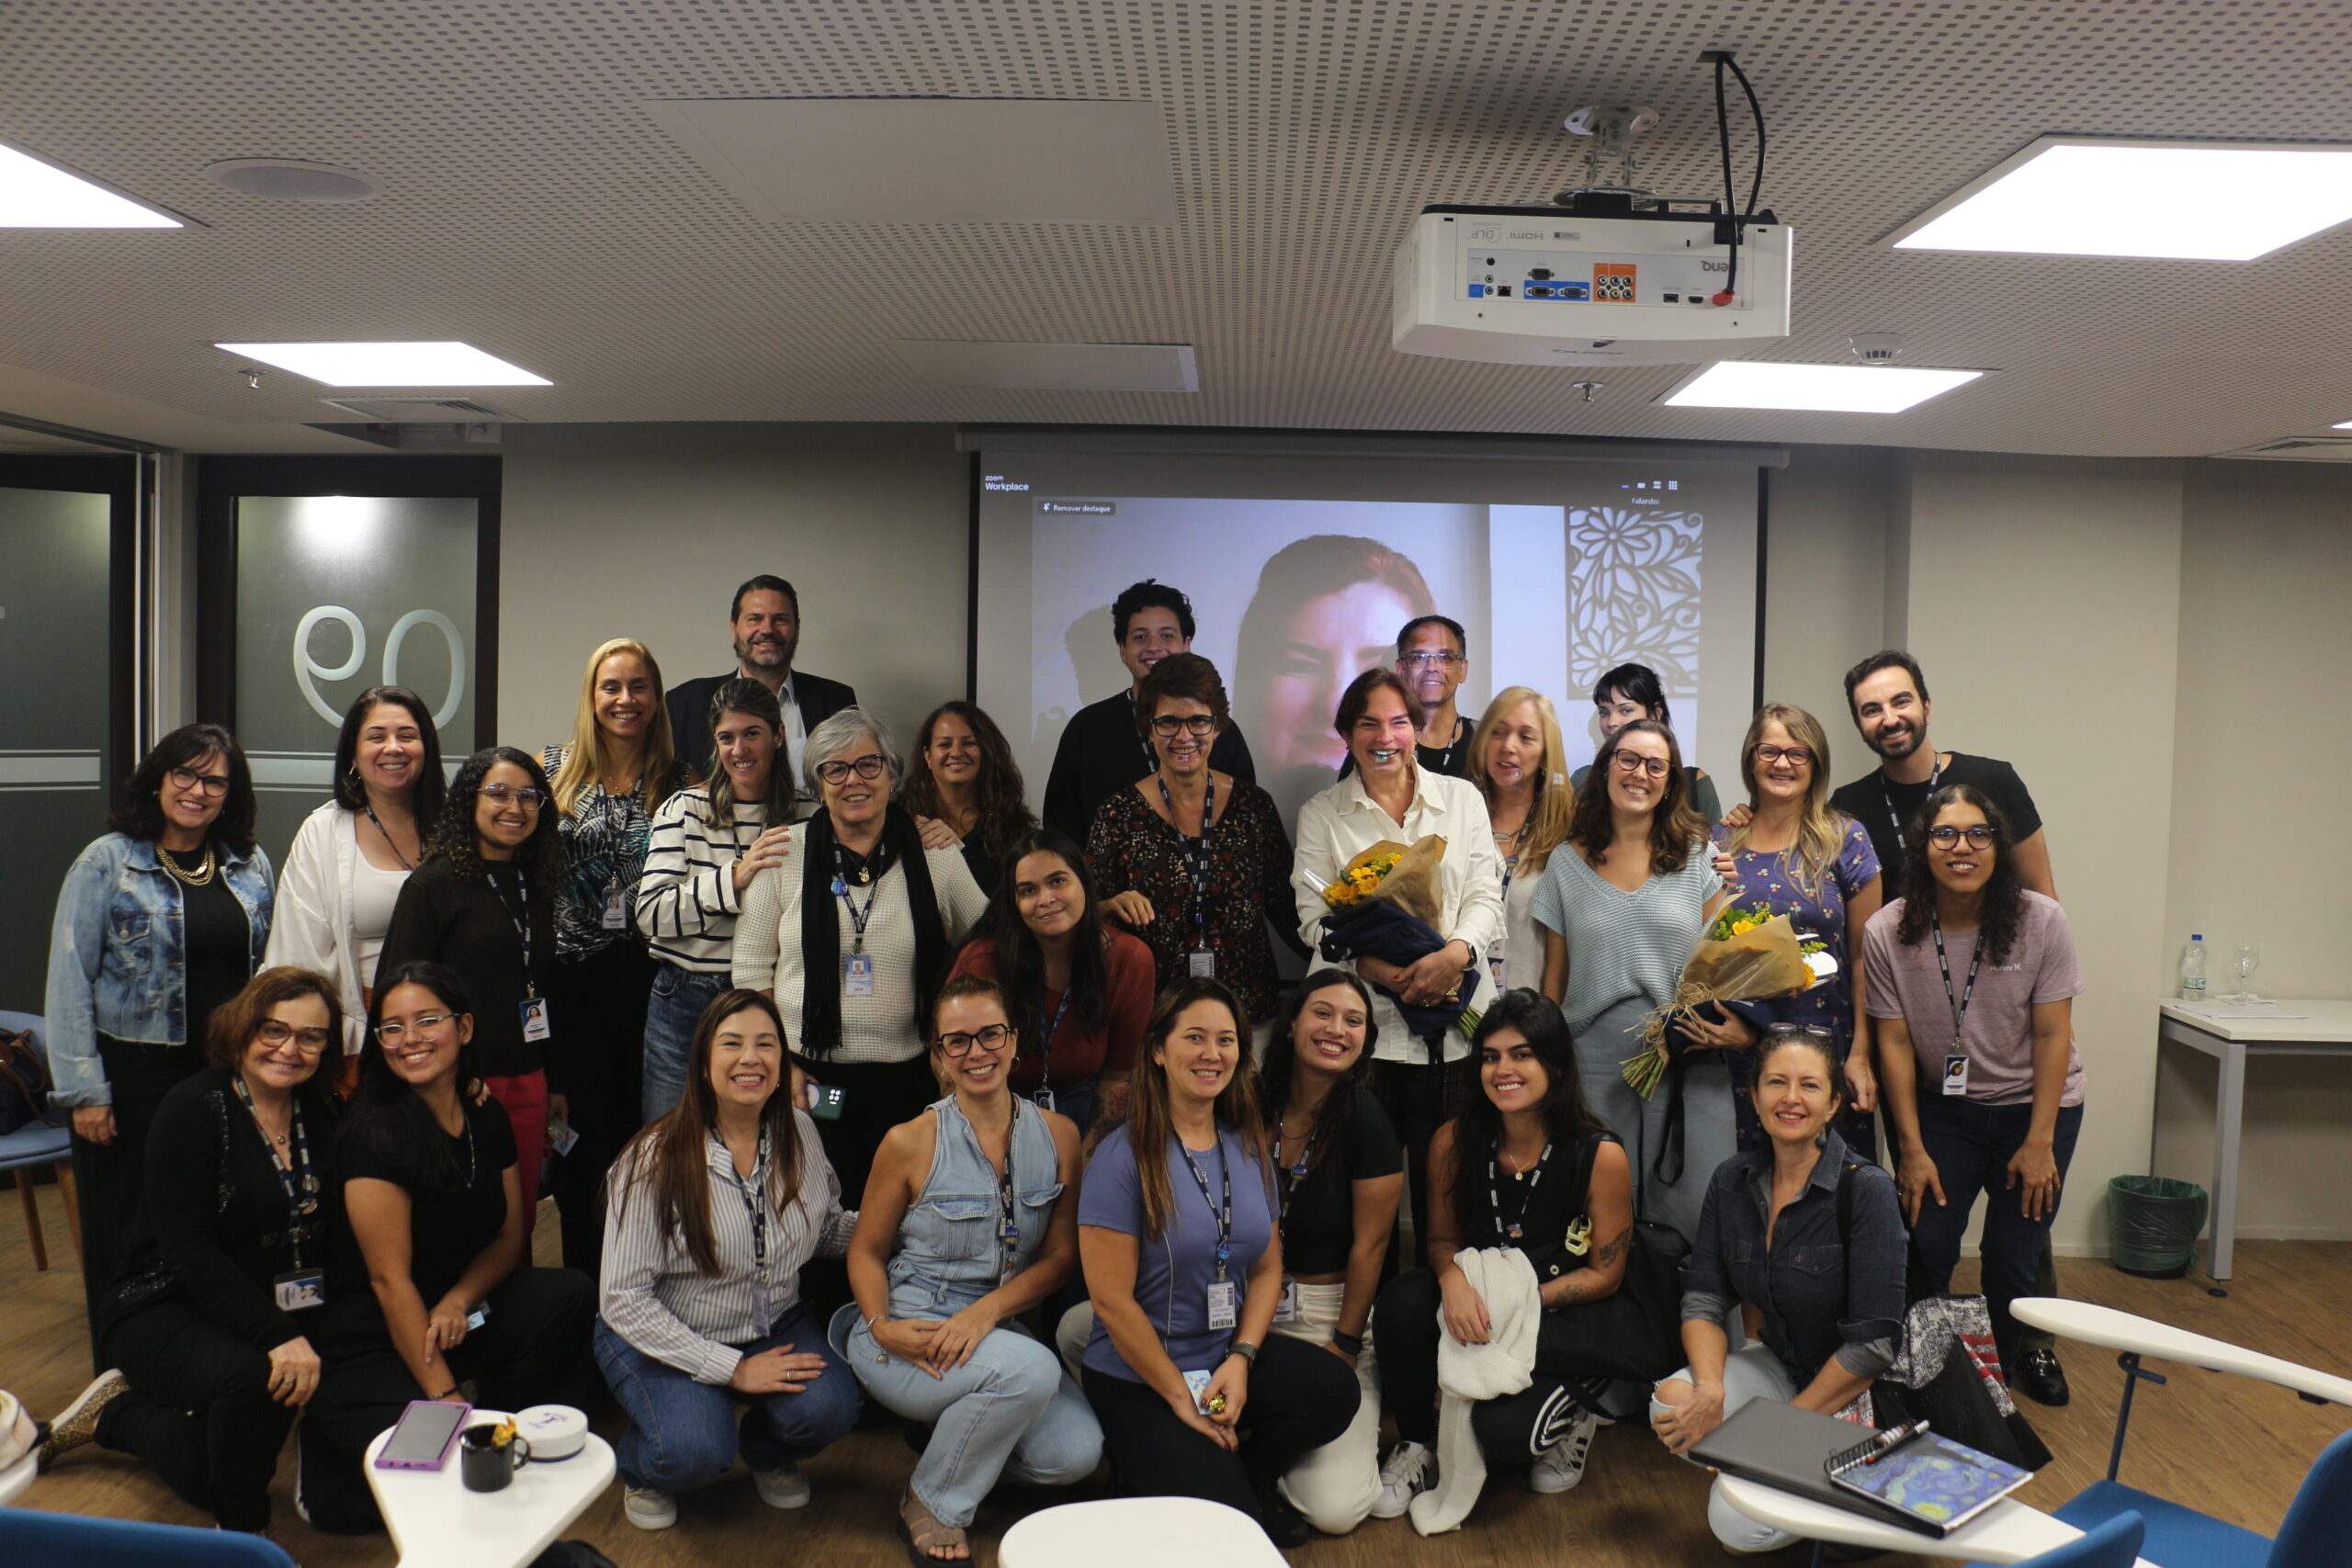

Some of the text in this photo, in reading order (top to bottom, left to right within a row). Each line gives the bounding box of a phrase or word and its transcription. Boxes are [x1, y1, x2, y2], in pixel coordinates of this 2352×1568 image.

[1471, 230, 1495, 240] DLP
[1701, 260, 1734, 272] enQ
[985, 482, 1029, 491] Workplace
[1053, 503, 1111, 513] Remover destaque
